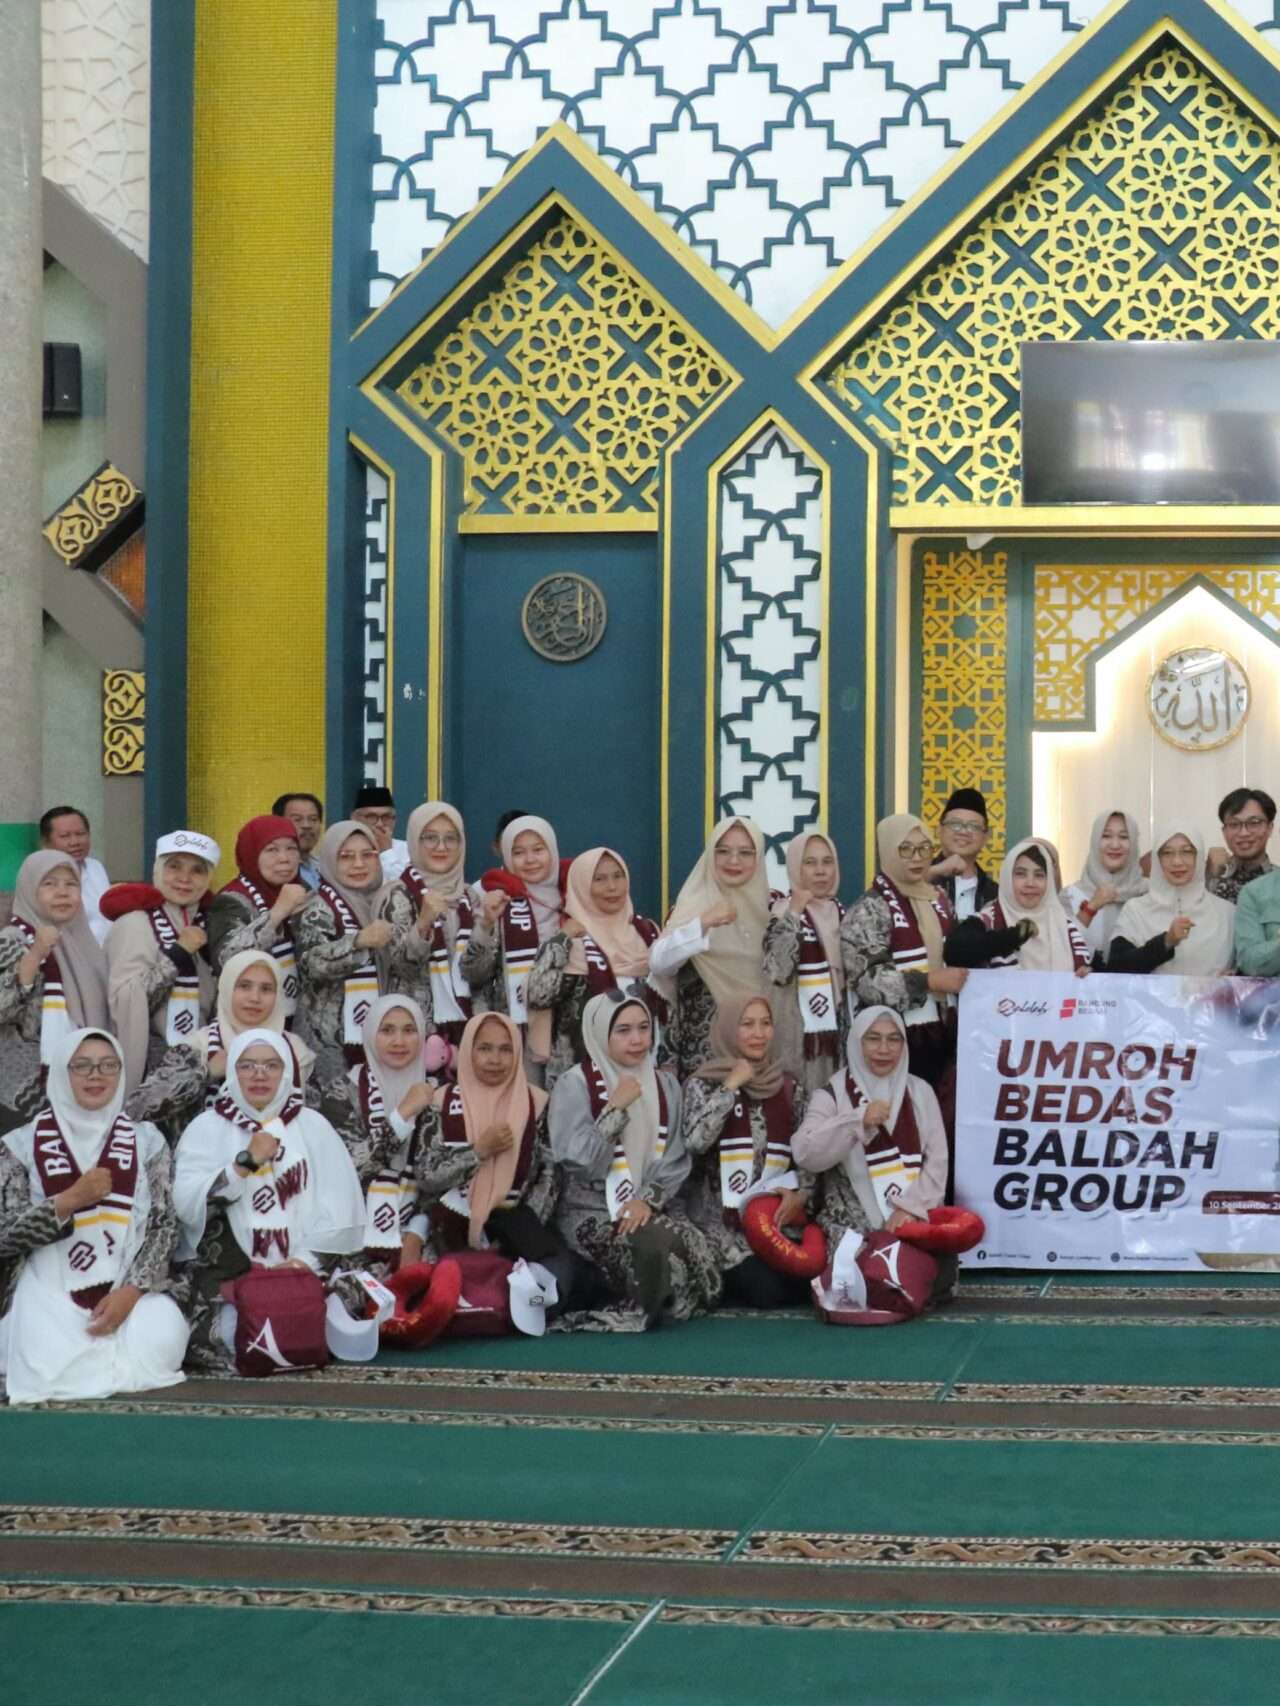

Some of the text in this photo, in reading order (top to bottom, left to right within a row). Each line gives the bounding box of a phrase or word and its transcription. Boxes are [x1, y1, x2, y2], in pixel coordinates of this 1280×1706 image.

[997, 1040, 1196, 1080] UMROH
[994, 1083, 1175, 1124] BEDAS
[993, 1128, 1218, 1169] BALDAH
[994, 1172, 1185, 1212] GROUP
